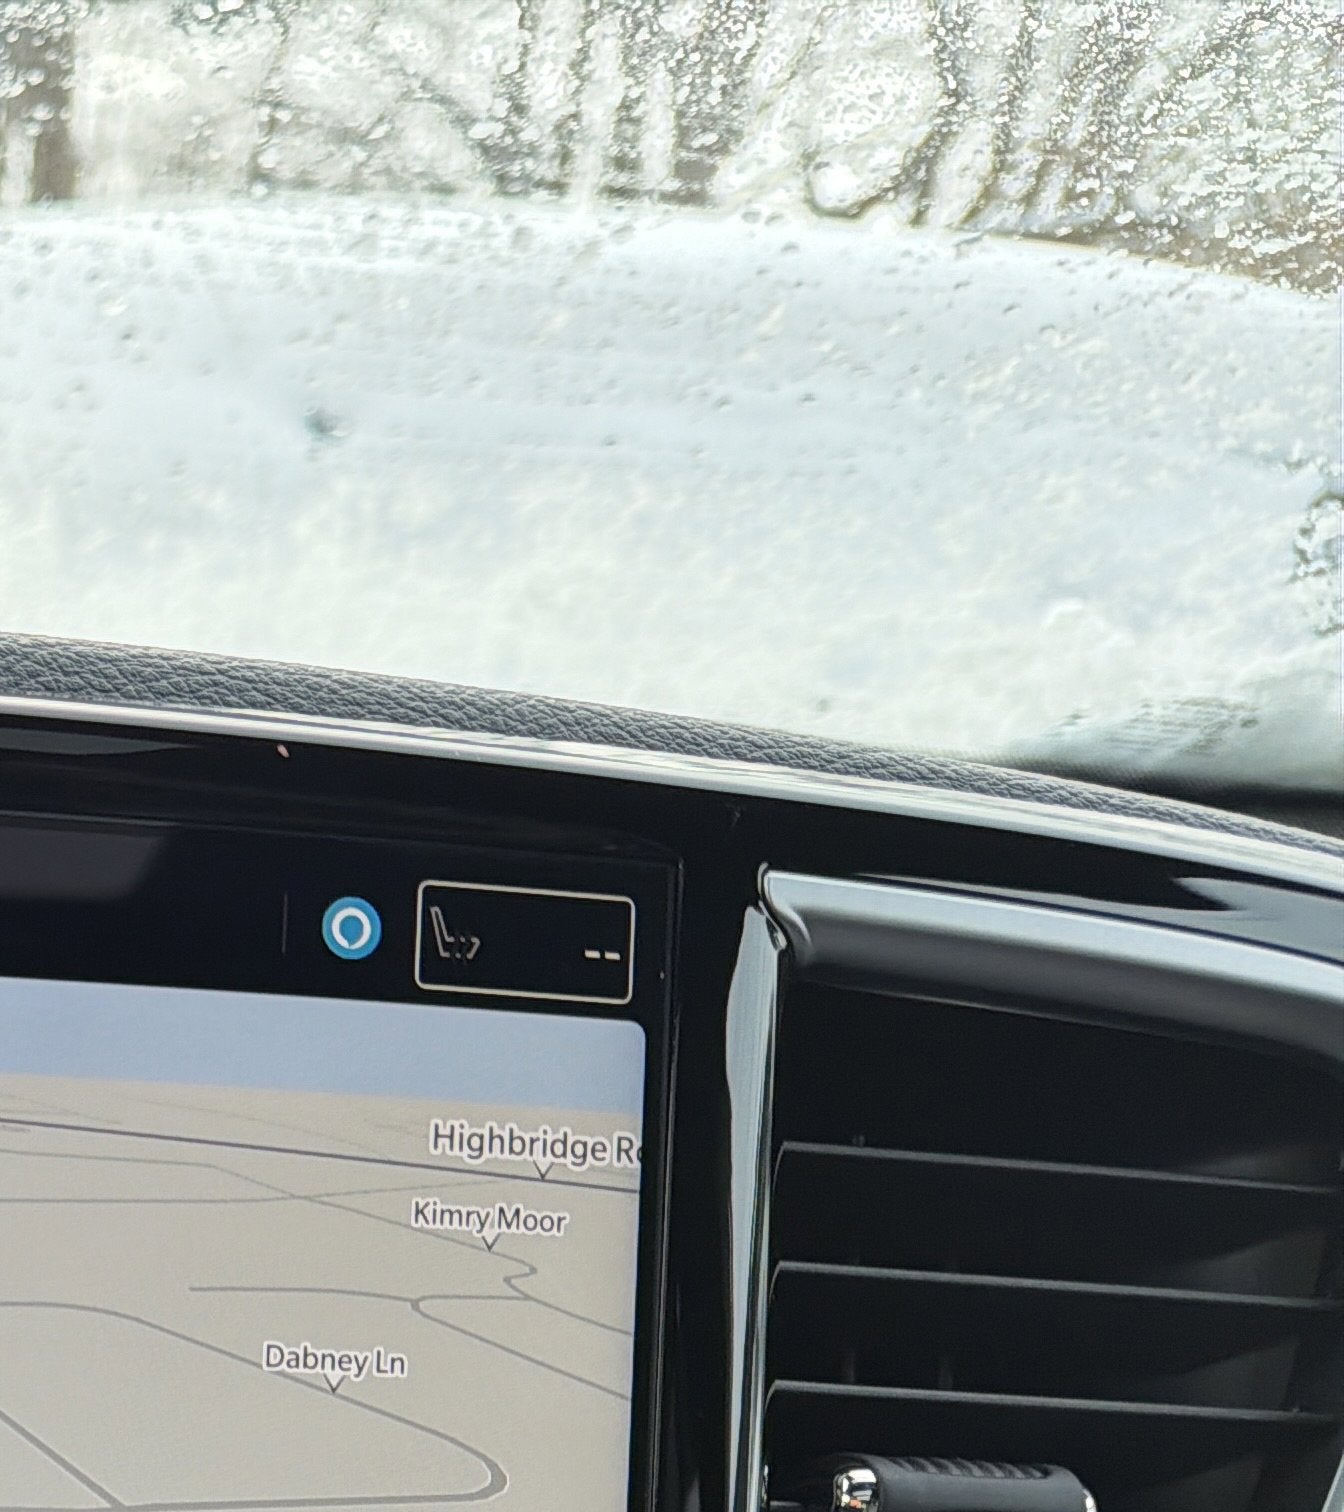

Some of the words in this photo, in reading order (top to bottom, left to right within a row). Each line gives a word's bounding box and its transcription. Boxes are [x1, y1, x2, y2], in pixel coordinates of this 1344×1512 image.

[432, 1124, 607, 1166] Highbridge
[414, 1202, 490, 1233] Kimry
[498, 1206, 567, 1233] Moor
[265, 1344, 368, 1378] Dabney
[374, 1350, 406, 1375] Ln
